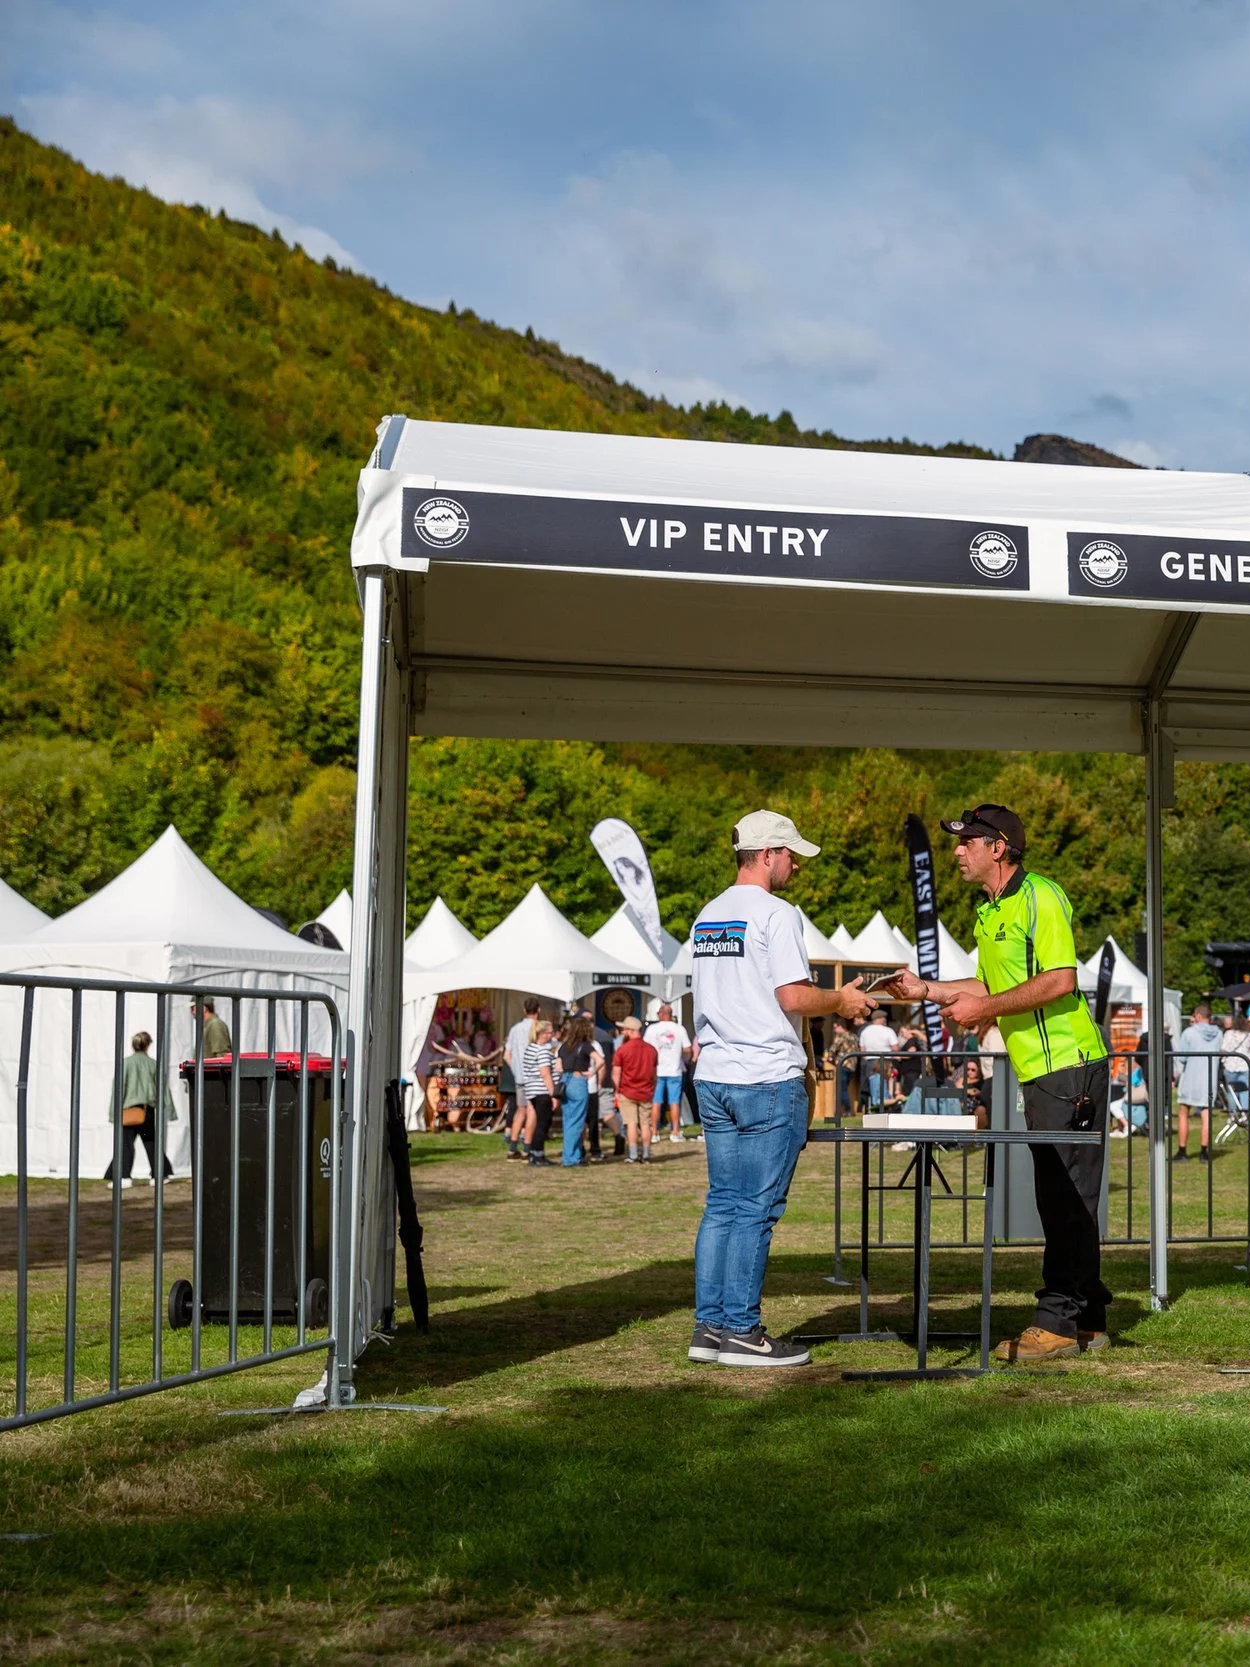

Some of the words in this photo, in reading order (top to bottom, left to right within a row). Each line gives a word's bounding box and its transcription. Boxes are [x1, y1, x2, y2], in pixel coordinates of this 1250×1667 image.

[422, 501, 436, 513] NEW
[435, 500, 462, 514] ZEALAND
[620, 517, 687, 549] VIP
[703, 522, 829, 557] ENTRY
[977, 534, 988, 545] NEW
[987, 533, 1011, 547] ZEALAND
[1086, 544, 1097, 555] NEW
[1096, 543, 1120, 556] ZEALAND
[914, 851, 932, 913] EAST
